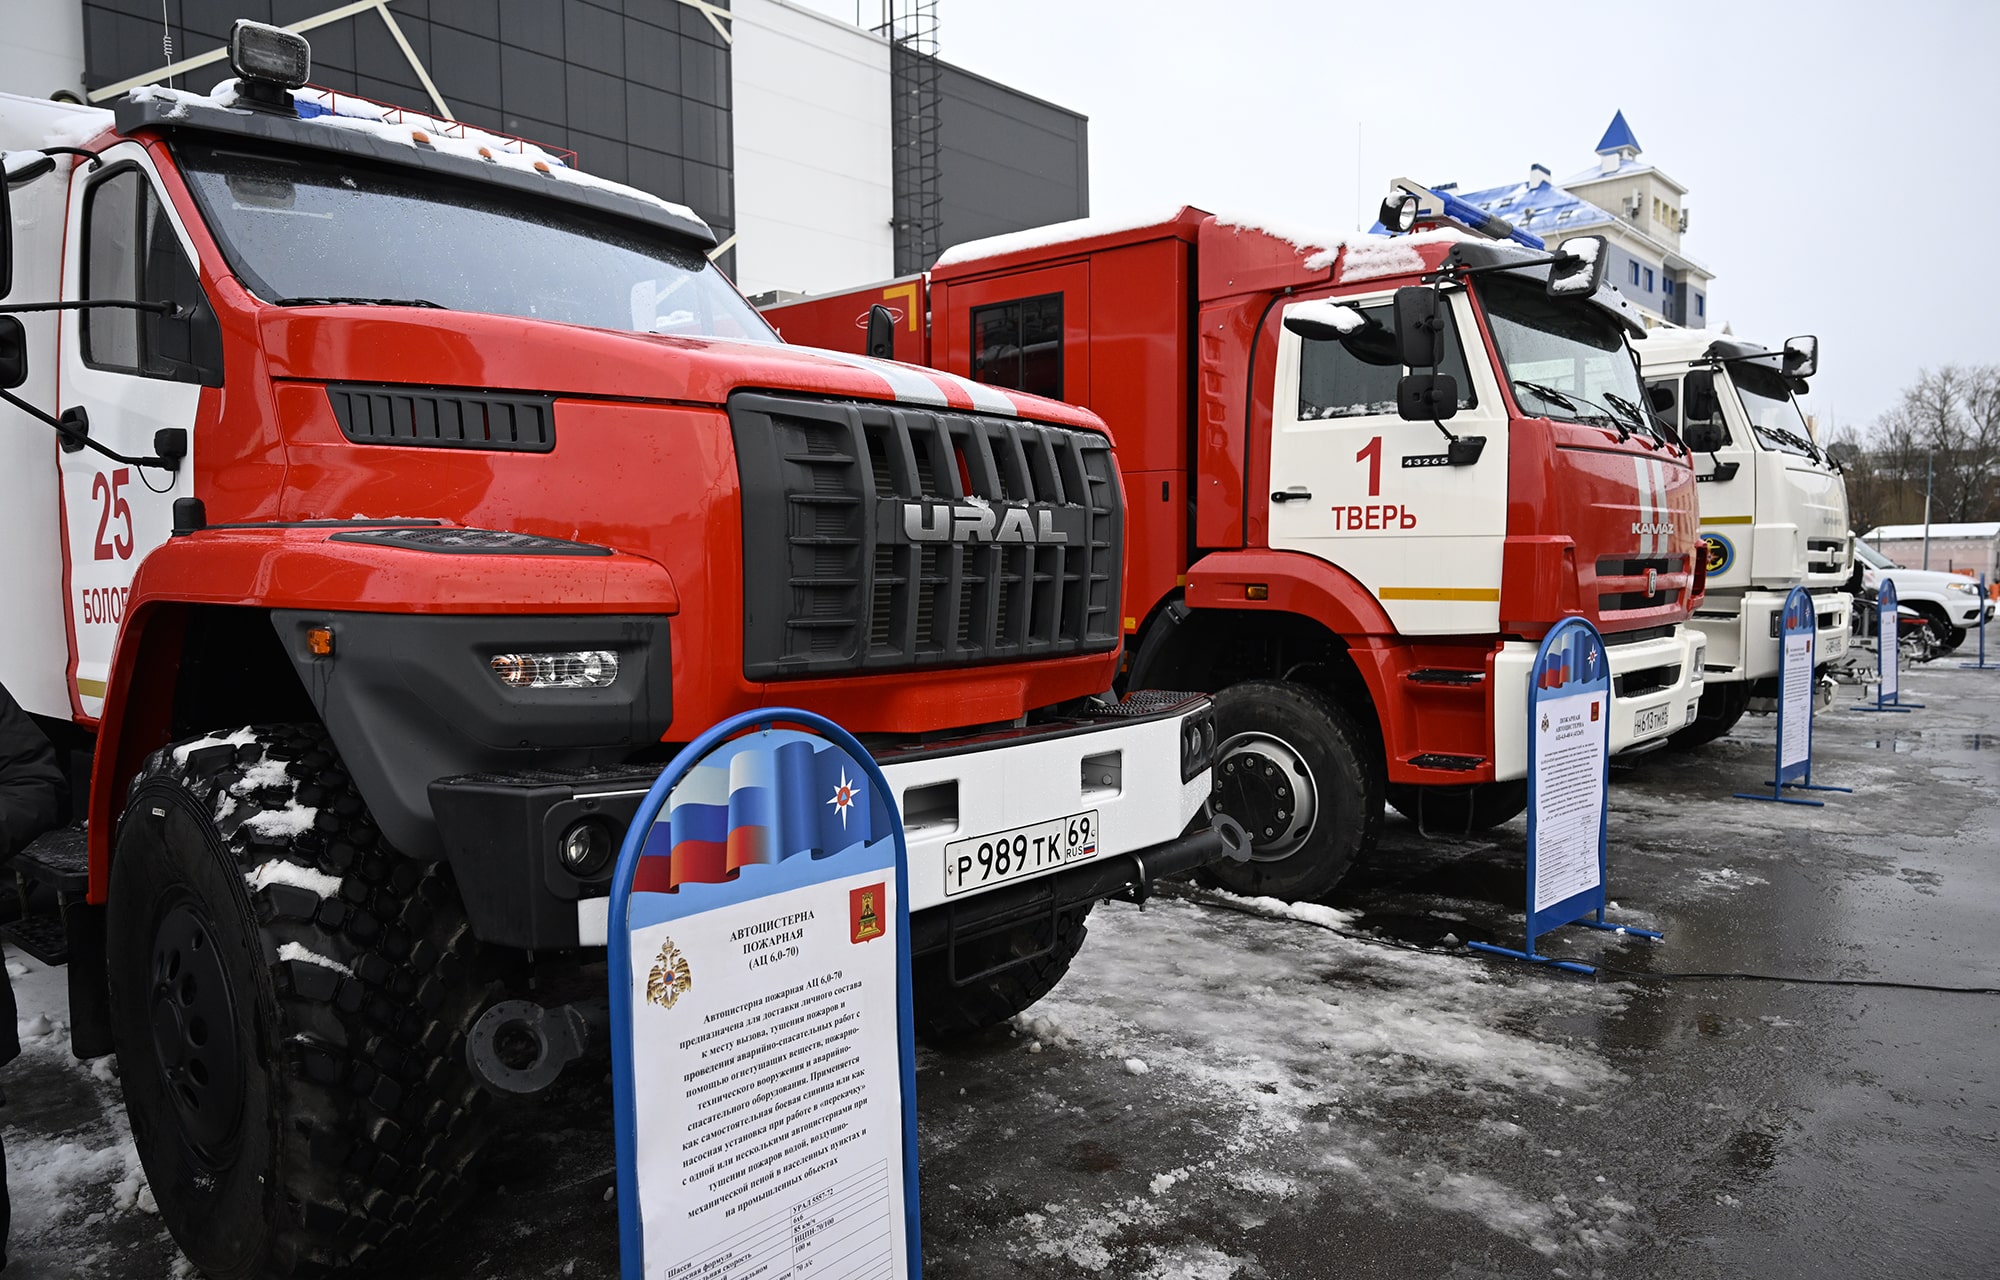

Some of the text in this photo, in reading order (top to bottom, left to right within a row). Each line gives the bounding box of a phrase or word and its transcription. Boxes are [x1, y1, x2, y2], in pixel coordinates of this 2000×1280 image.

[1356, 436, 1382, 497] 1
[1404, 457, 1449, 466] 43265
[92, 468, 134, 561] 25
[904, 503, 1068, 542] URAL
[1331, 504, 1417, 530] ТВЕРЬ
[1631, 522, 1674, 534] KAMAZ
[1068, 817, 1090, 846] 69
[1066, 846, 1083, 858] RUS
[730, 910, 815, 942] АВТОЦИСТЕРНА
[743, 928, 804, 954] ПОЖАРНАЯ
[749, 946, 799, 970] (АЦ 6,0-70)
[680, 980, 862, 1050] предназначена для доставки личного состава
[704, 970, 842, 1024] Автоцистерна пожарная АЦ 6,0-70
[684, 1056, 735, 1082] проведения
[736, 1022, 832, 1062] аварийно-спасательных
[834, 1013, 854, 1028] работ
[702, 1050, 708, 1058] к
[710, 1040, 735, 1056] месту
[736, 1028, 768, 1046] вызова,
[770, 1016, 804, 1034] тушения
[806, 1004, 839, 1020] пожаров
[686, 1028, 860, 1098] помощью огнетушащих веществ, пожарно-
[698, 1082, 754, 1110] технического
[756, 1062, 804, 1087] вооружения
[813, 1045, 852, 1064] аварийно-
[682, 1069, 865, 1151] как самостоятельная боевая единица или как
[688, 1056, 860, 1131] спасательного оборудования. Применяется
[682, 1084, 866, 1168] насосная установка при работе в «перекачку»
[682, 1098, 868, 1186] с одной или несколькими автоцистернами при
[688, 1182, 748, 1219] механической
[750, 1170, 774, 1189] пеной
[783, 1148, 828, 1172] населенных
[830, 1132, 860, 1150] пунктах
[862, 1128, 867, 1136] и
[708, 1122, 848, 1192] тушении пожаров водой, воздушно-
[725, 1157, 838, 1218] на промышленных объектах
[793, 1200, 811, 1214] УРАЛ
[794, 1218, 816, 1234] 85 км/ч
[703, 1252, 732, 1272] формула
[723, 1253, 752, 1272] скорость
[796, 1242, 806, 1253] 100
[796, 1260, 813, 1272] 70 л/с
[668, 1262, 692, 1278] Шасси
